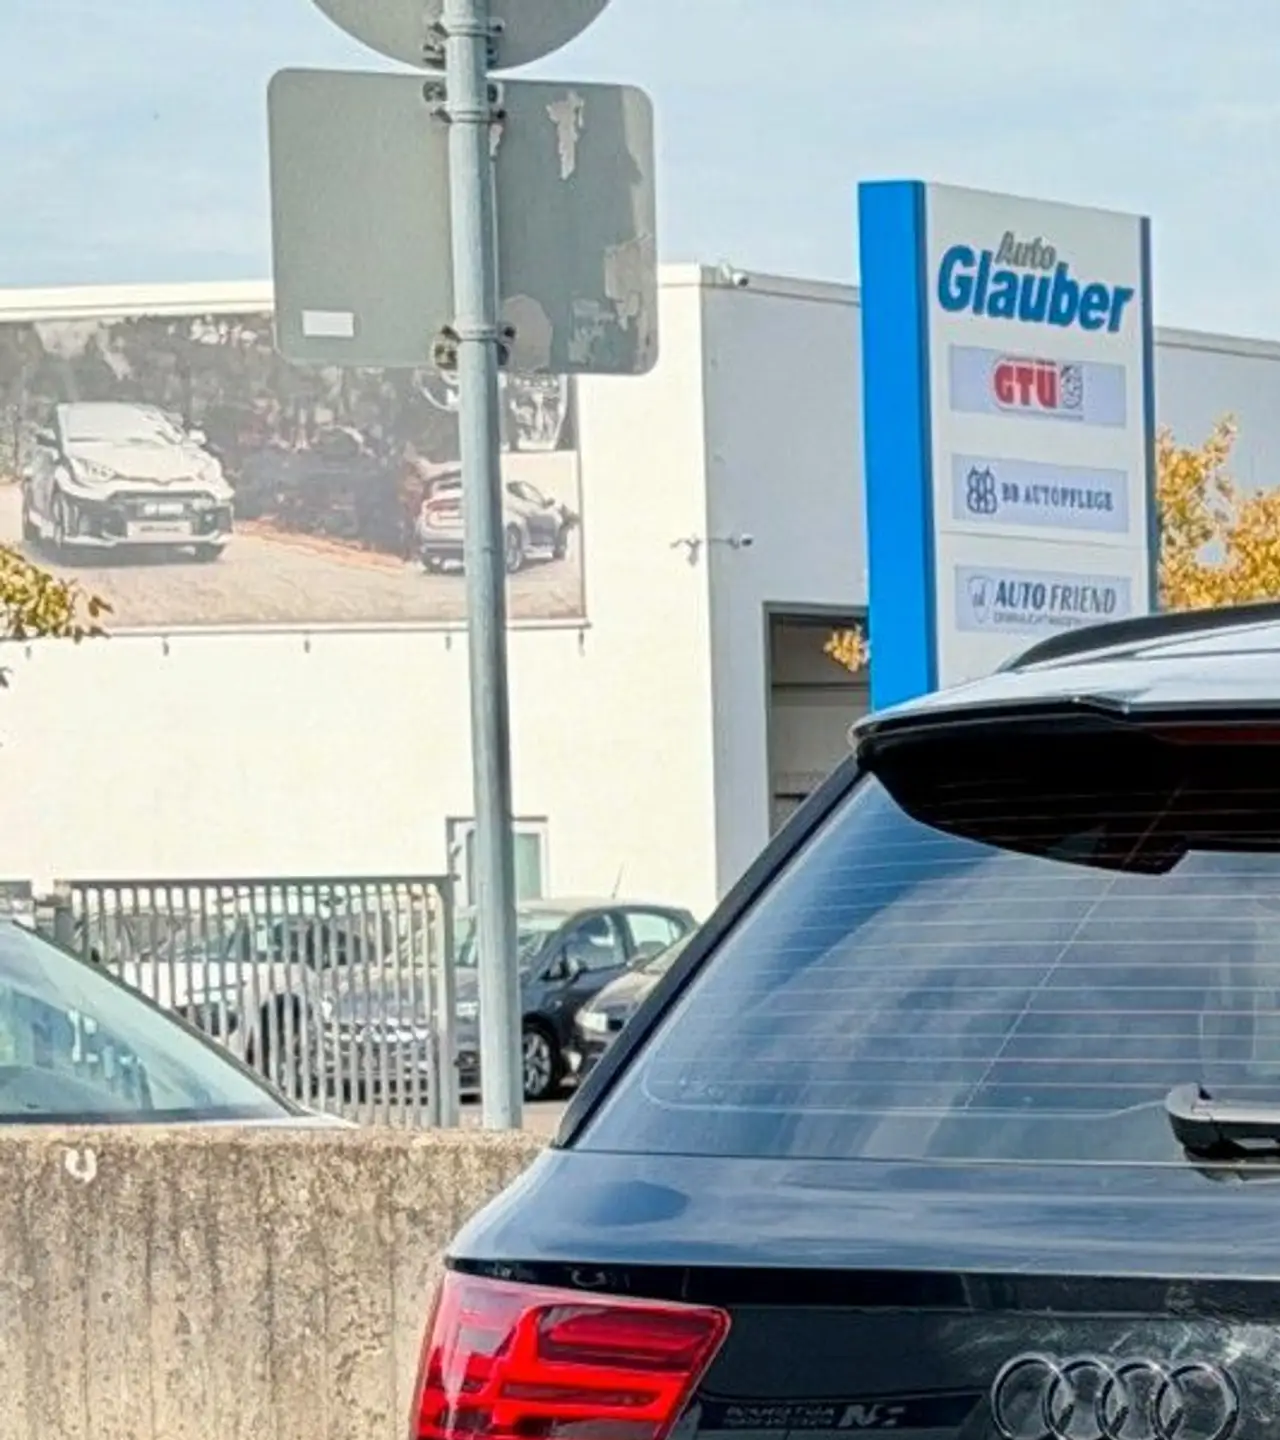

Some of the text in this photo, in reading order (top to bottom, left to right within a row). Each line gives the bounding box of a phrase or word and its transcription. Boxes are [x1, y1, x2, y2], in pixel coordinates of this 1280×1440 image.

[995, 230, 1057, 269] Auto
[937, 243, 1135, 334] Glauber
[1023, 485, 1115, 512] AUTOPFLEGE
[995, 580, 1117, 615] AUTO FRIEND
